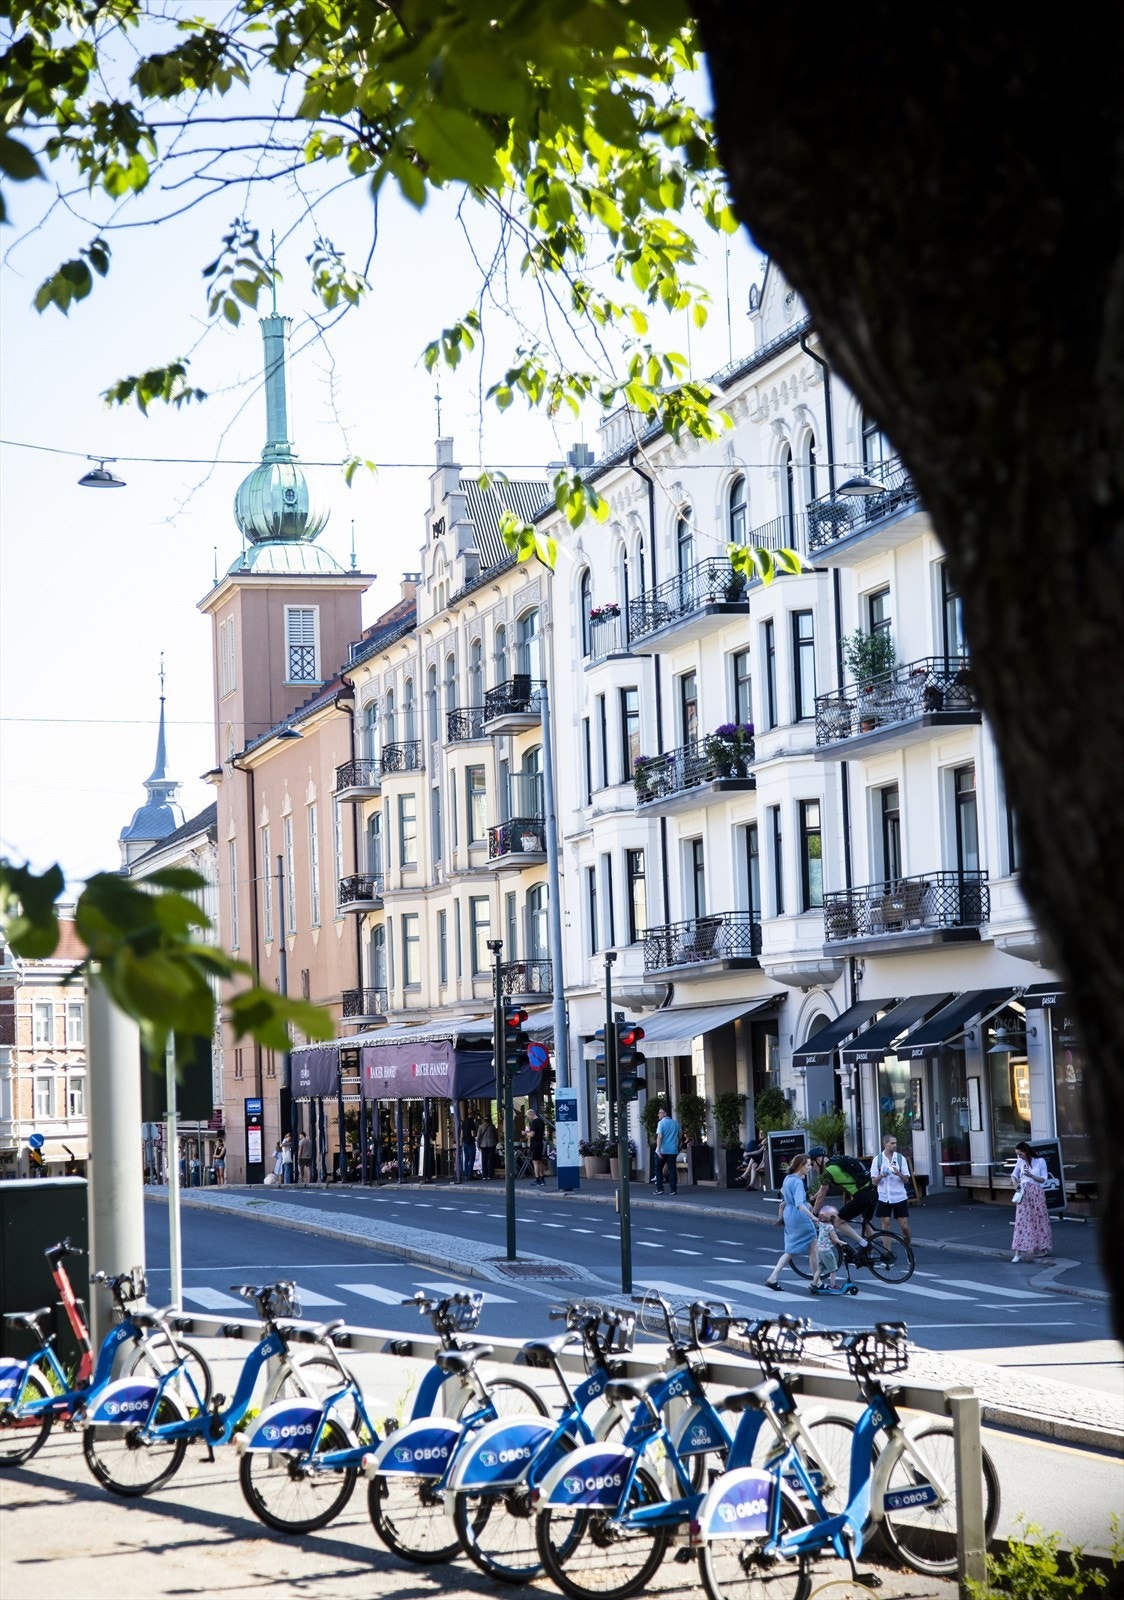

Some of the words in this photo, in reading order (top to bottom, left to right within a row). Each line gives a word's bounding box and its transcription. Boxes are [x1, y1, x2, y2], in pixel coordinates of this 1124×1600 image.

[120, 1399, 149, 1412] OBOS
[280, 1422, 312, 1438] OBOS
[691, 1437, 711, 1446] OBOS
[414, 1446, 448, 1461] OBOS
[498, 1447, 531, 1463] OBOS
[585, 1474, 621, 1491] OBOS
[792, 1476, 817, 1488] OS
[902, 1491, 928, 1505] OBOS
[735, 1498, 768, 1518] OBOS
